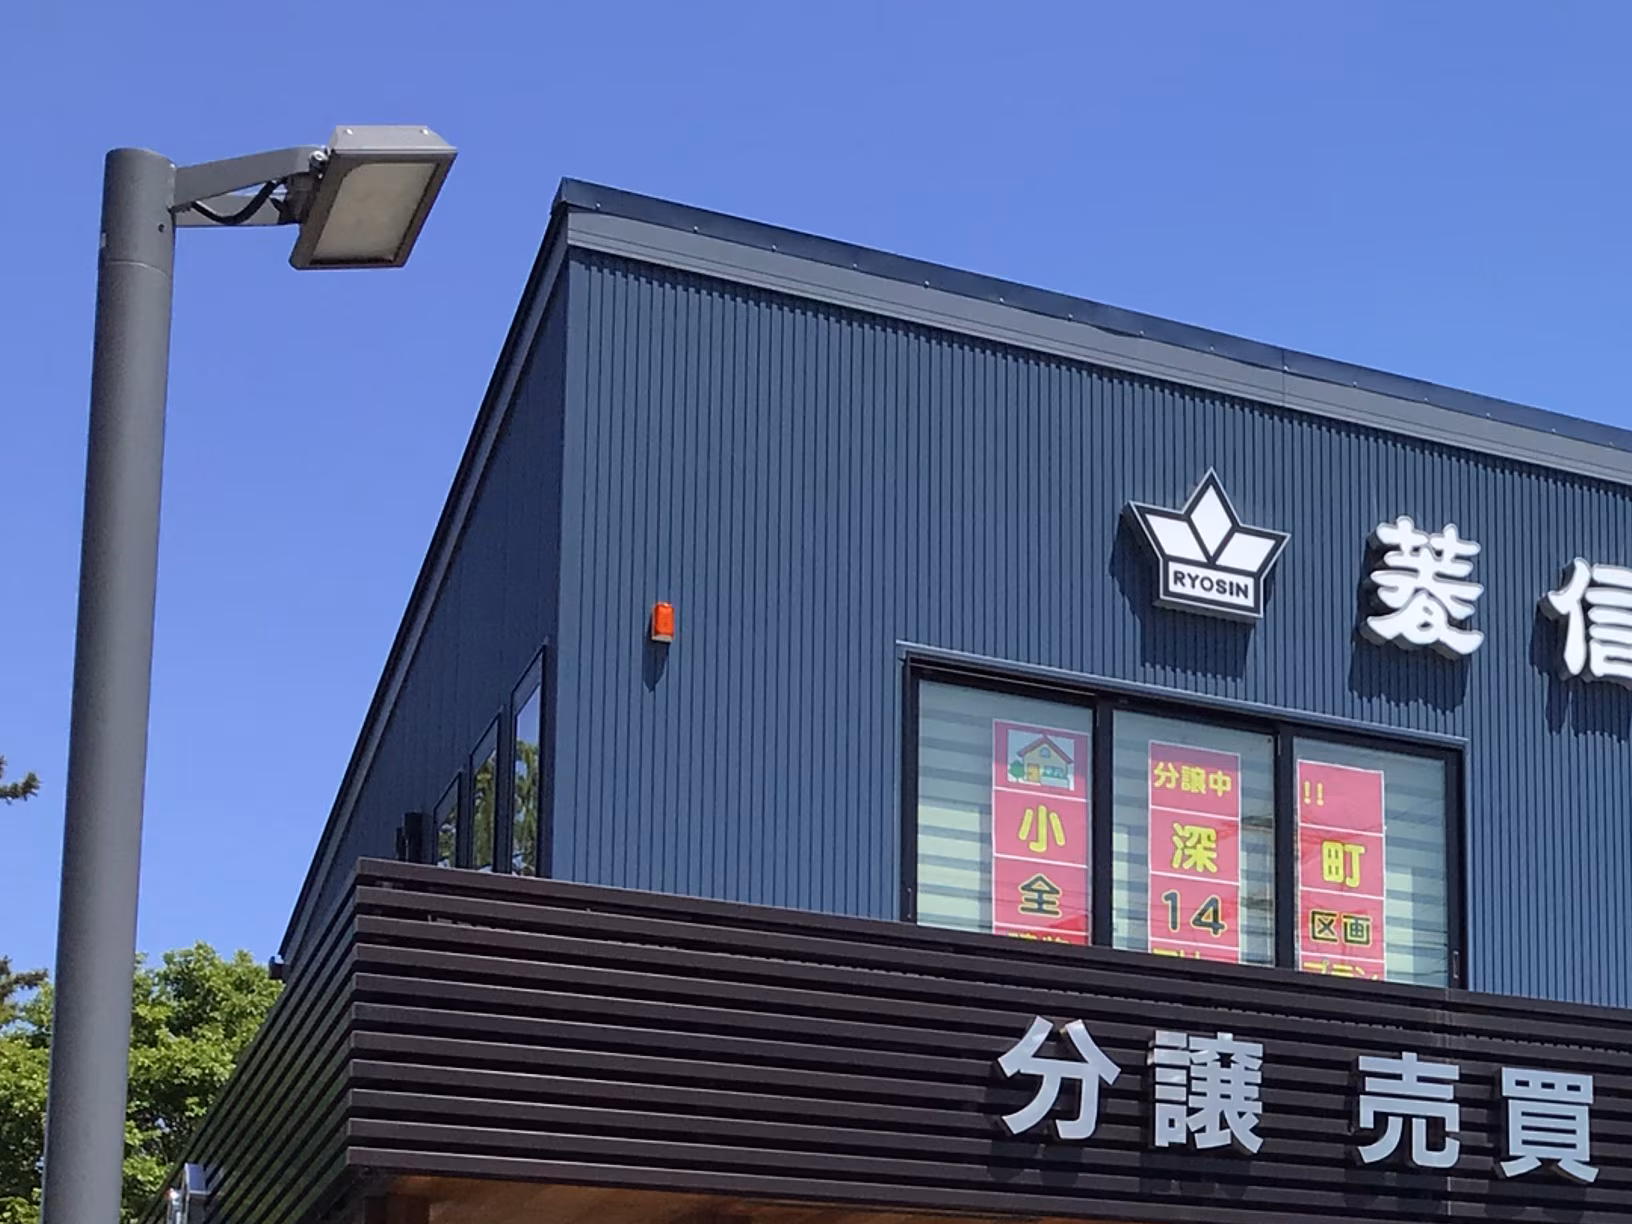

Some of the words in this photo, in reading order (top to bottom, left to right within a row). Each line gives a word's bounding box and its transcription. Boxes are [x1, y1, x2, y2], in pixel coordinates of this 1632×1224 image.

[1173, 570, 1249, 599] RYOSIN
[1153, 761, 1233, 798] 分譲中
[997, 1014, 1264, 1156] 分譲
[1357, 1050, 1599, 1184] 売買
